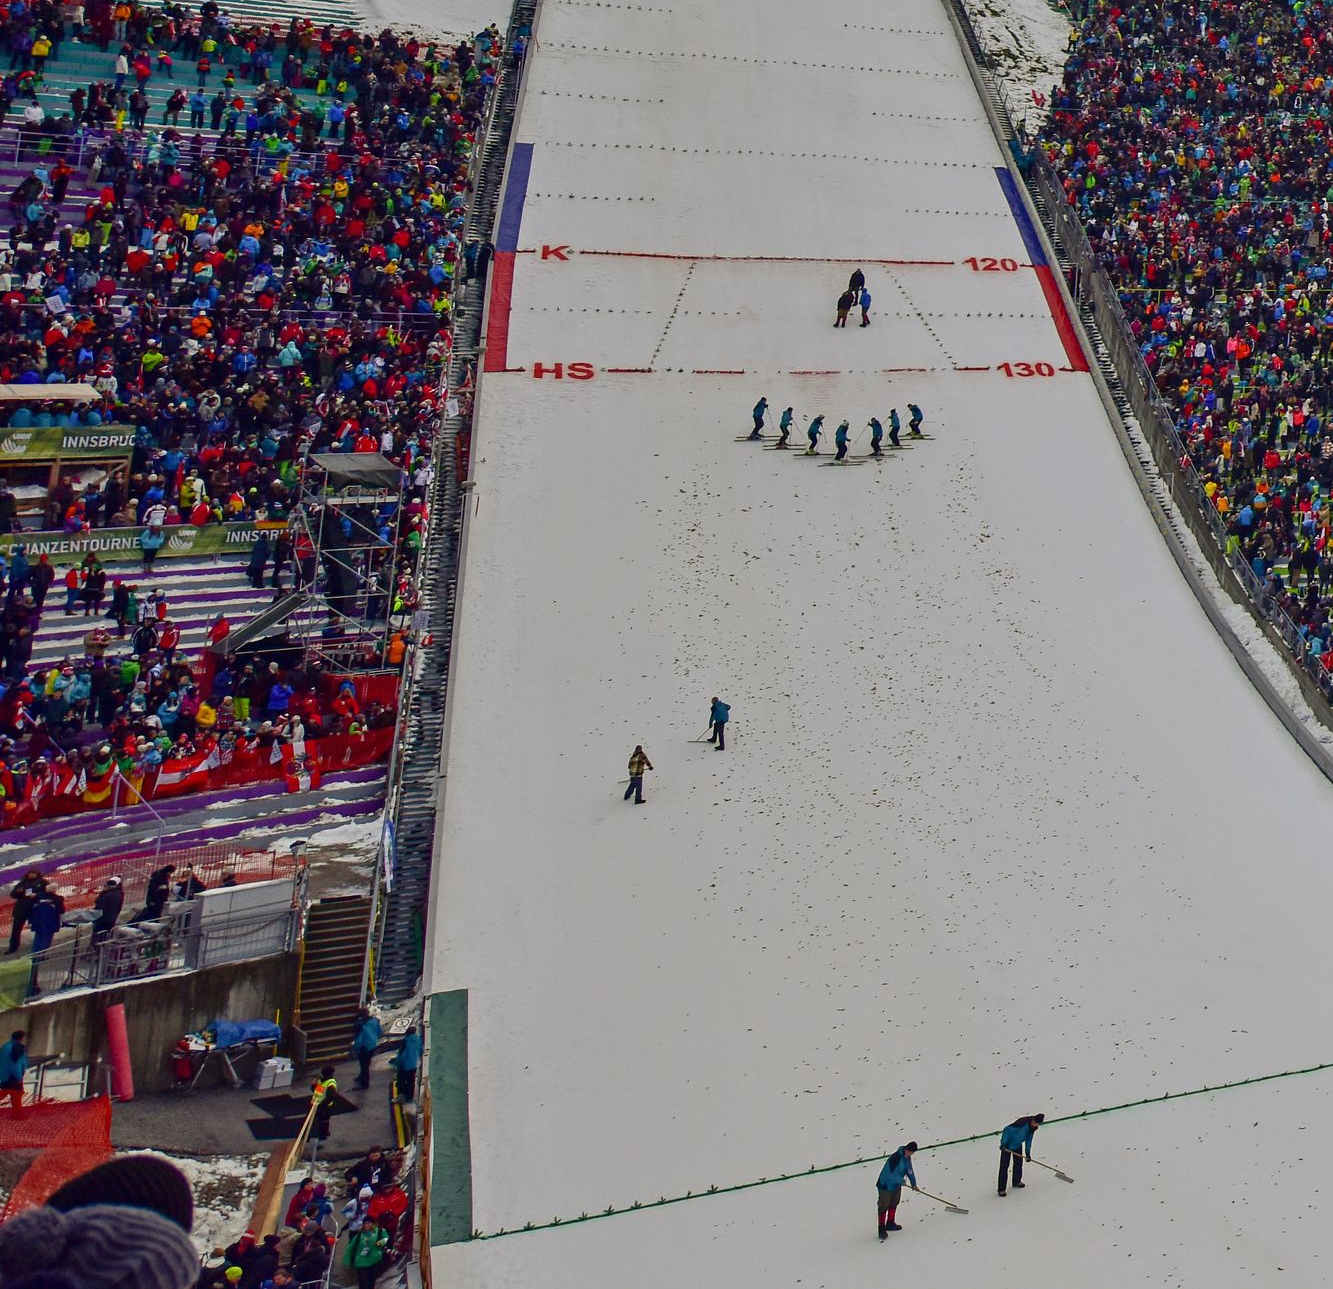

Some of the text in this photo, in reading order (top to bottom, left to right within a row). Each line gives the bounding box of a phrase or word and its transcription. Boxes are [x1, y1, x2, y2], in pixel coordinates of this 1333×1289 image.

[541, 245, 570, 260] K
[964, 257, 1018, 272] 120
[533, 362, 595, 380] HS
[997, 362, 1055, 377] 130
